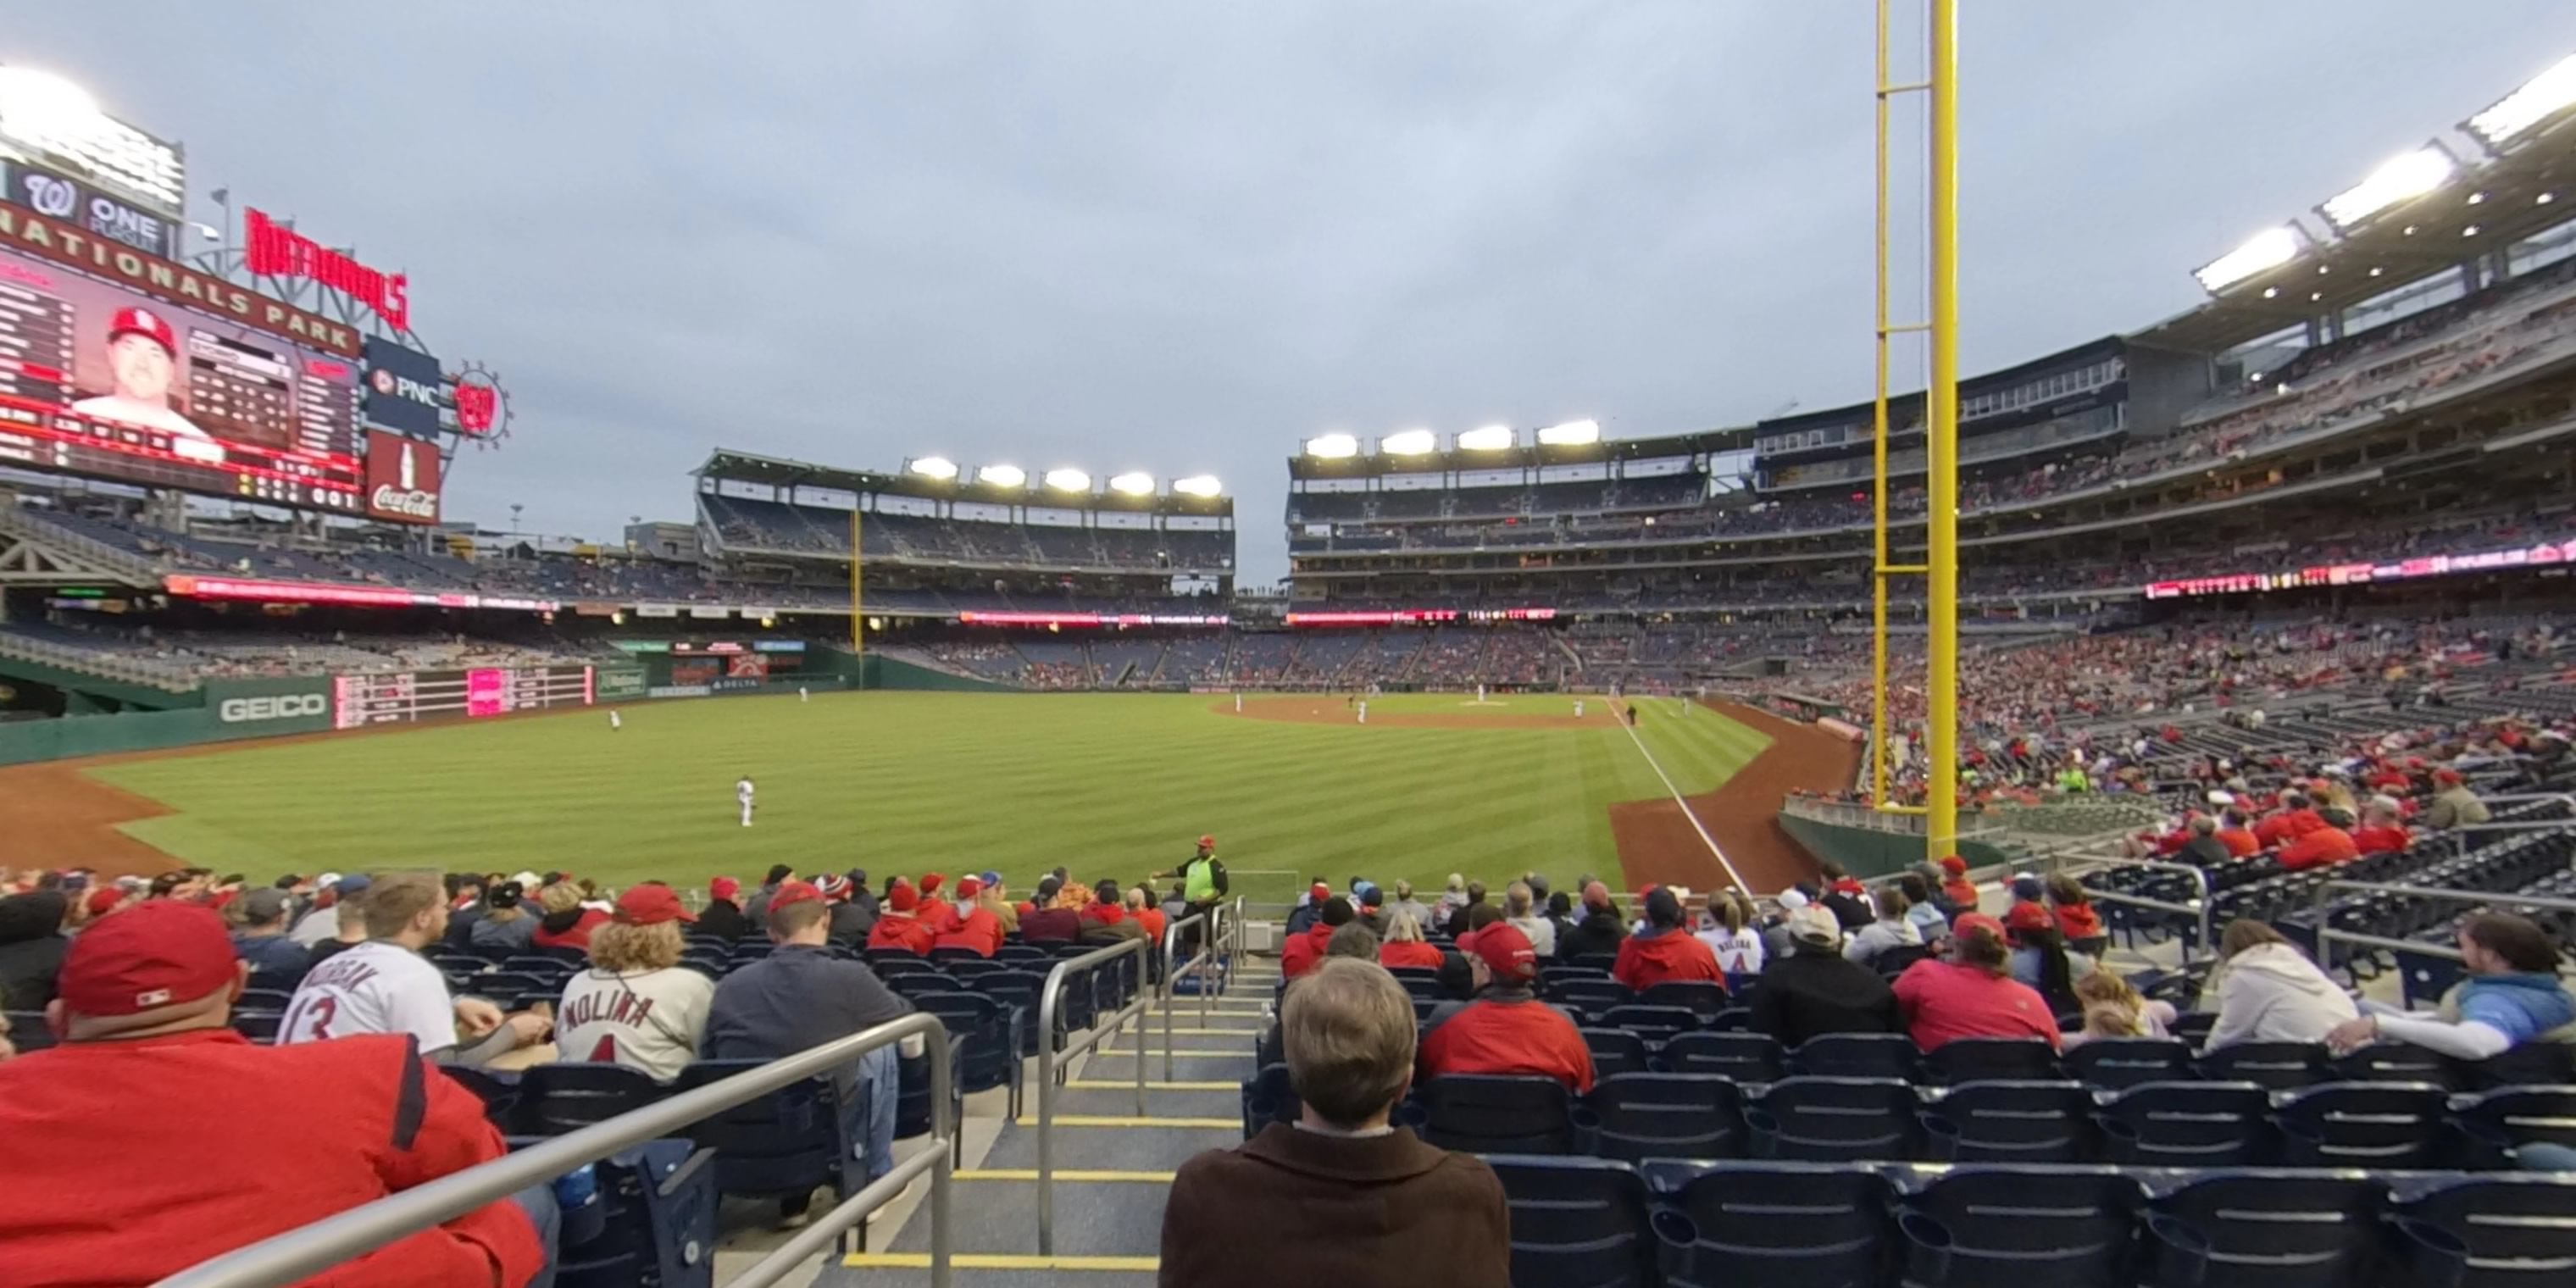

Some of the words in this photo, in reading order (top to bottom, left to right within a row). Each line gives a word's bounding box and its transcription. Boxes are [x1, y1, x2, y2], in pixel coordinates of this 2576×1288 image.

[91, 197, 159, 239] ONE
[265, 304, 347, 348] PARK
[396, 375, 440, 408] PNC
[220, 693, 326, 722] GEICO
[564, 989, 653, 1033] MOLINA
